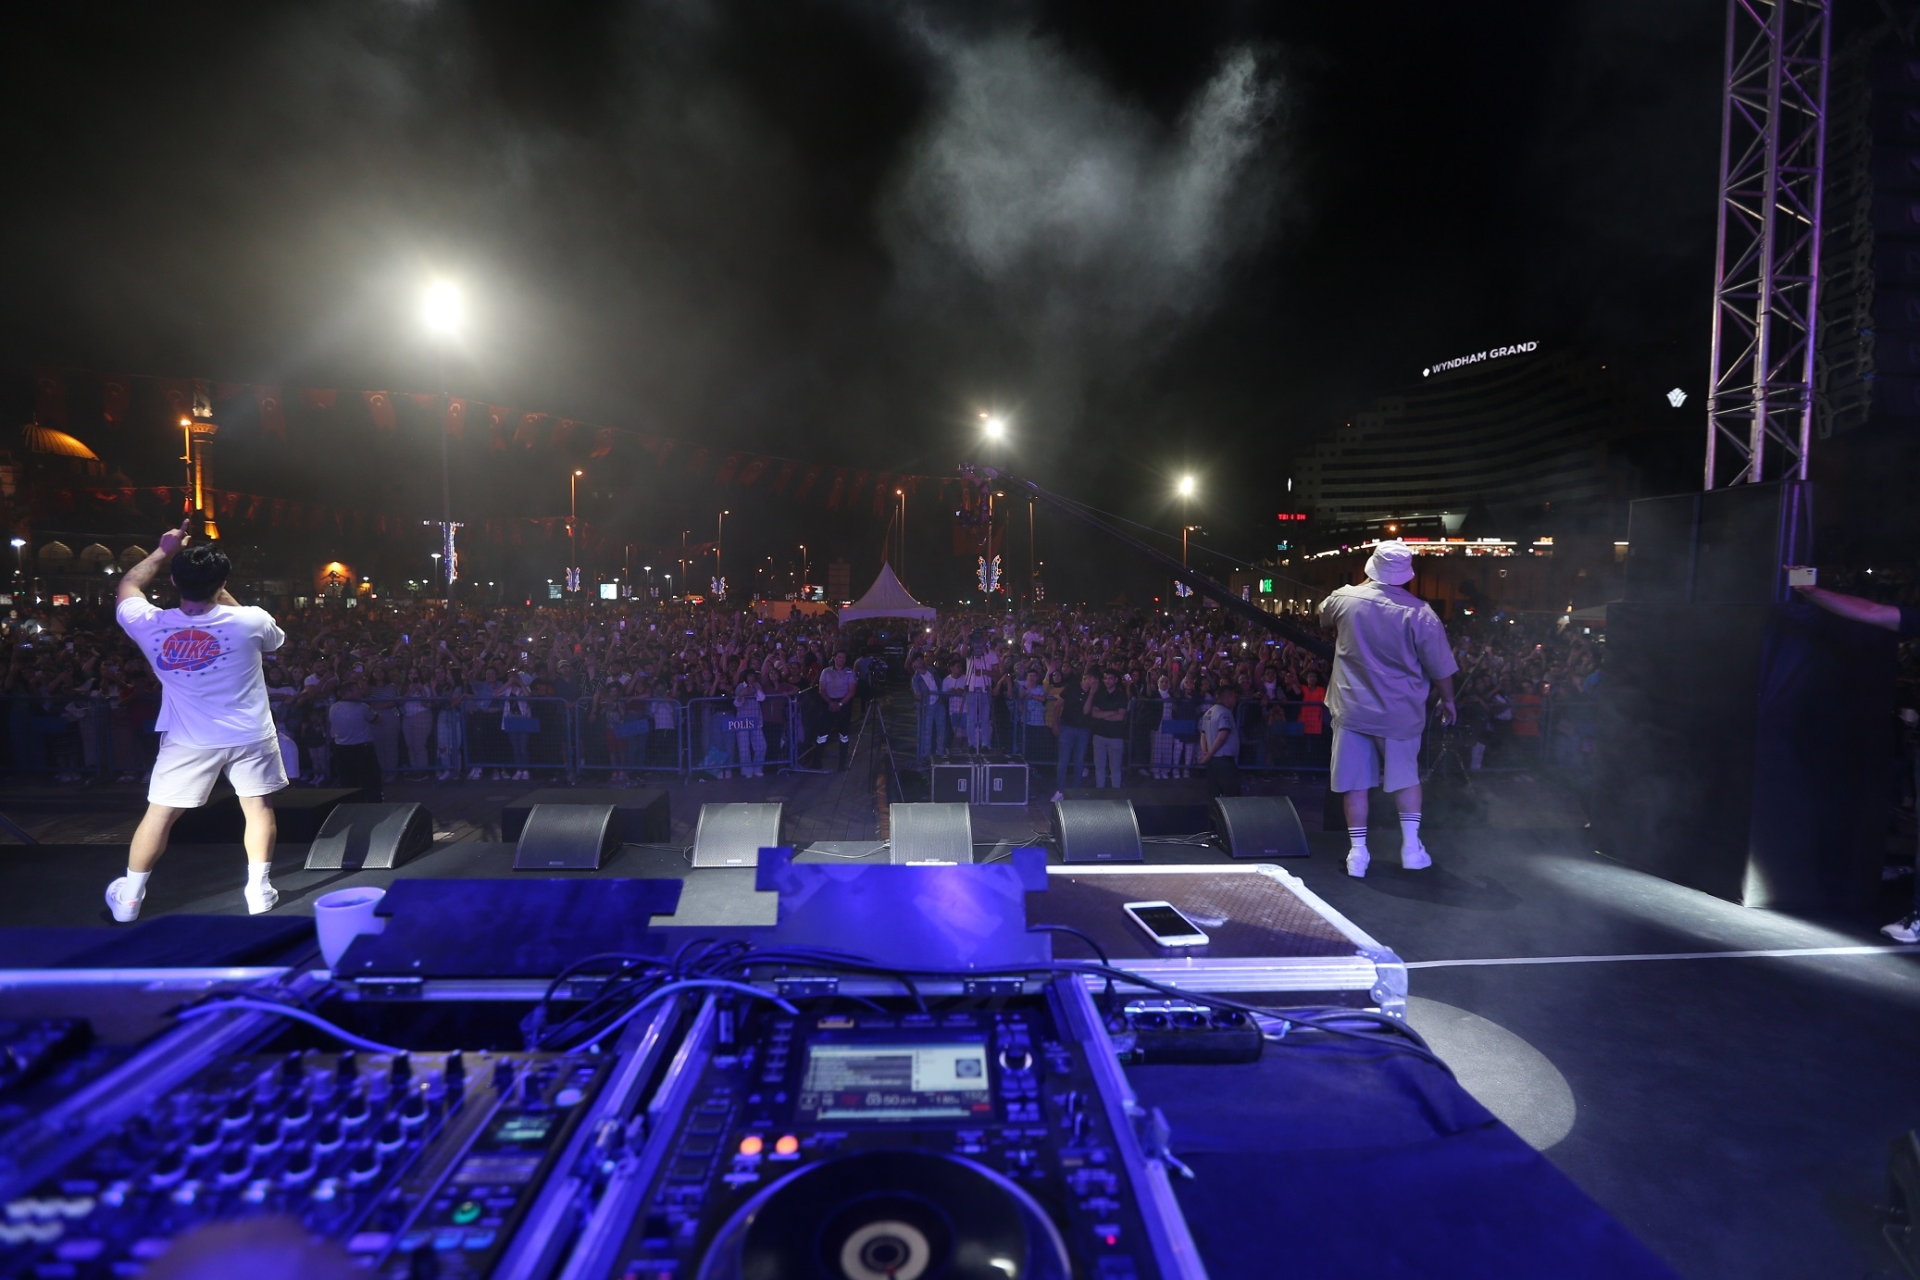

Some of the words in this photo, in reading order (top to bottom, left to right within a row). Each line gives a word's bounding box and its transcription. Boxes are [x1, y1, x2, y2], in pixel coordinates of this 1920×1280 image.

[1432, 351, 1487, 373] WYNDHAM
[1489, 341, 1537, 358] GRAND
[163, 640, 220, 660] NIKE
[728, 718, 755, 730] POLİS
